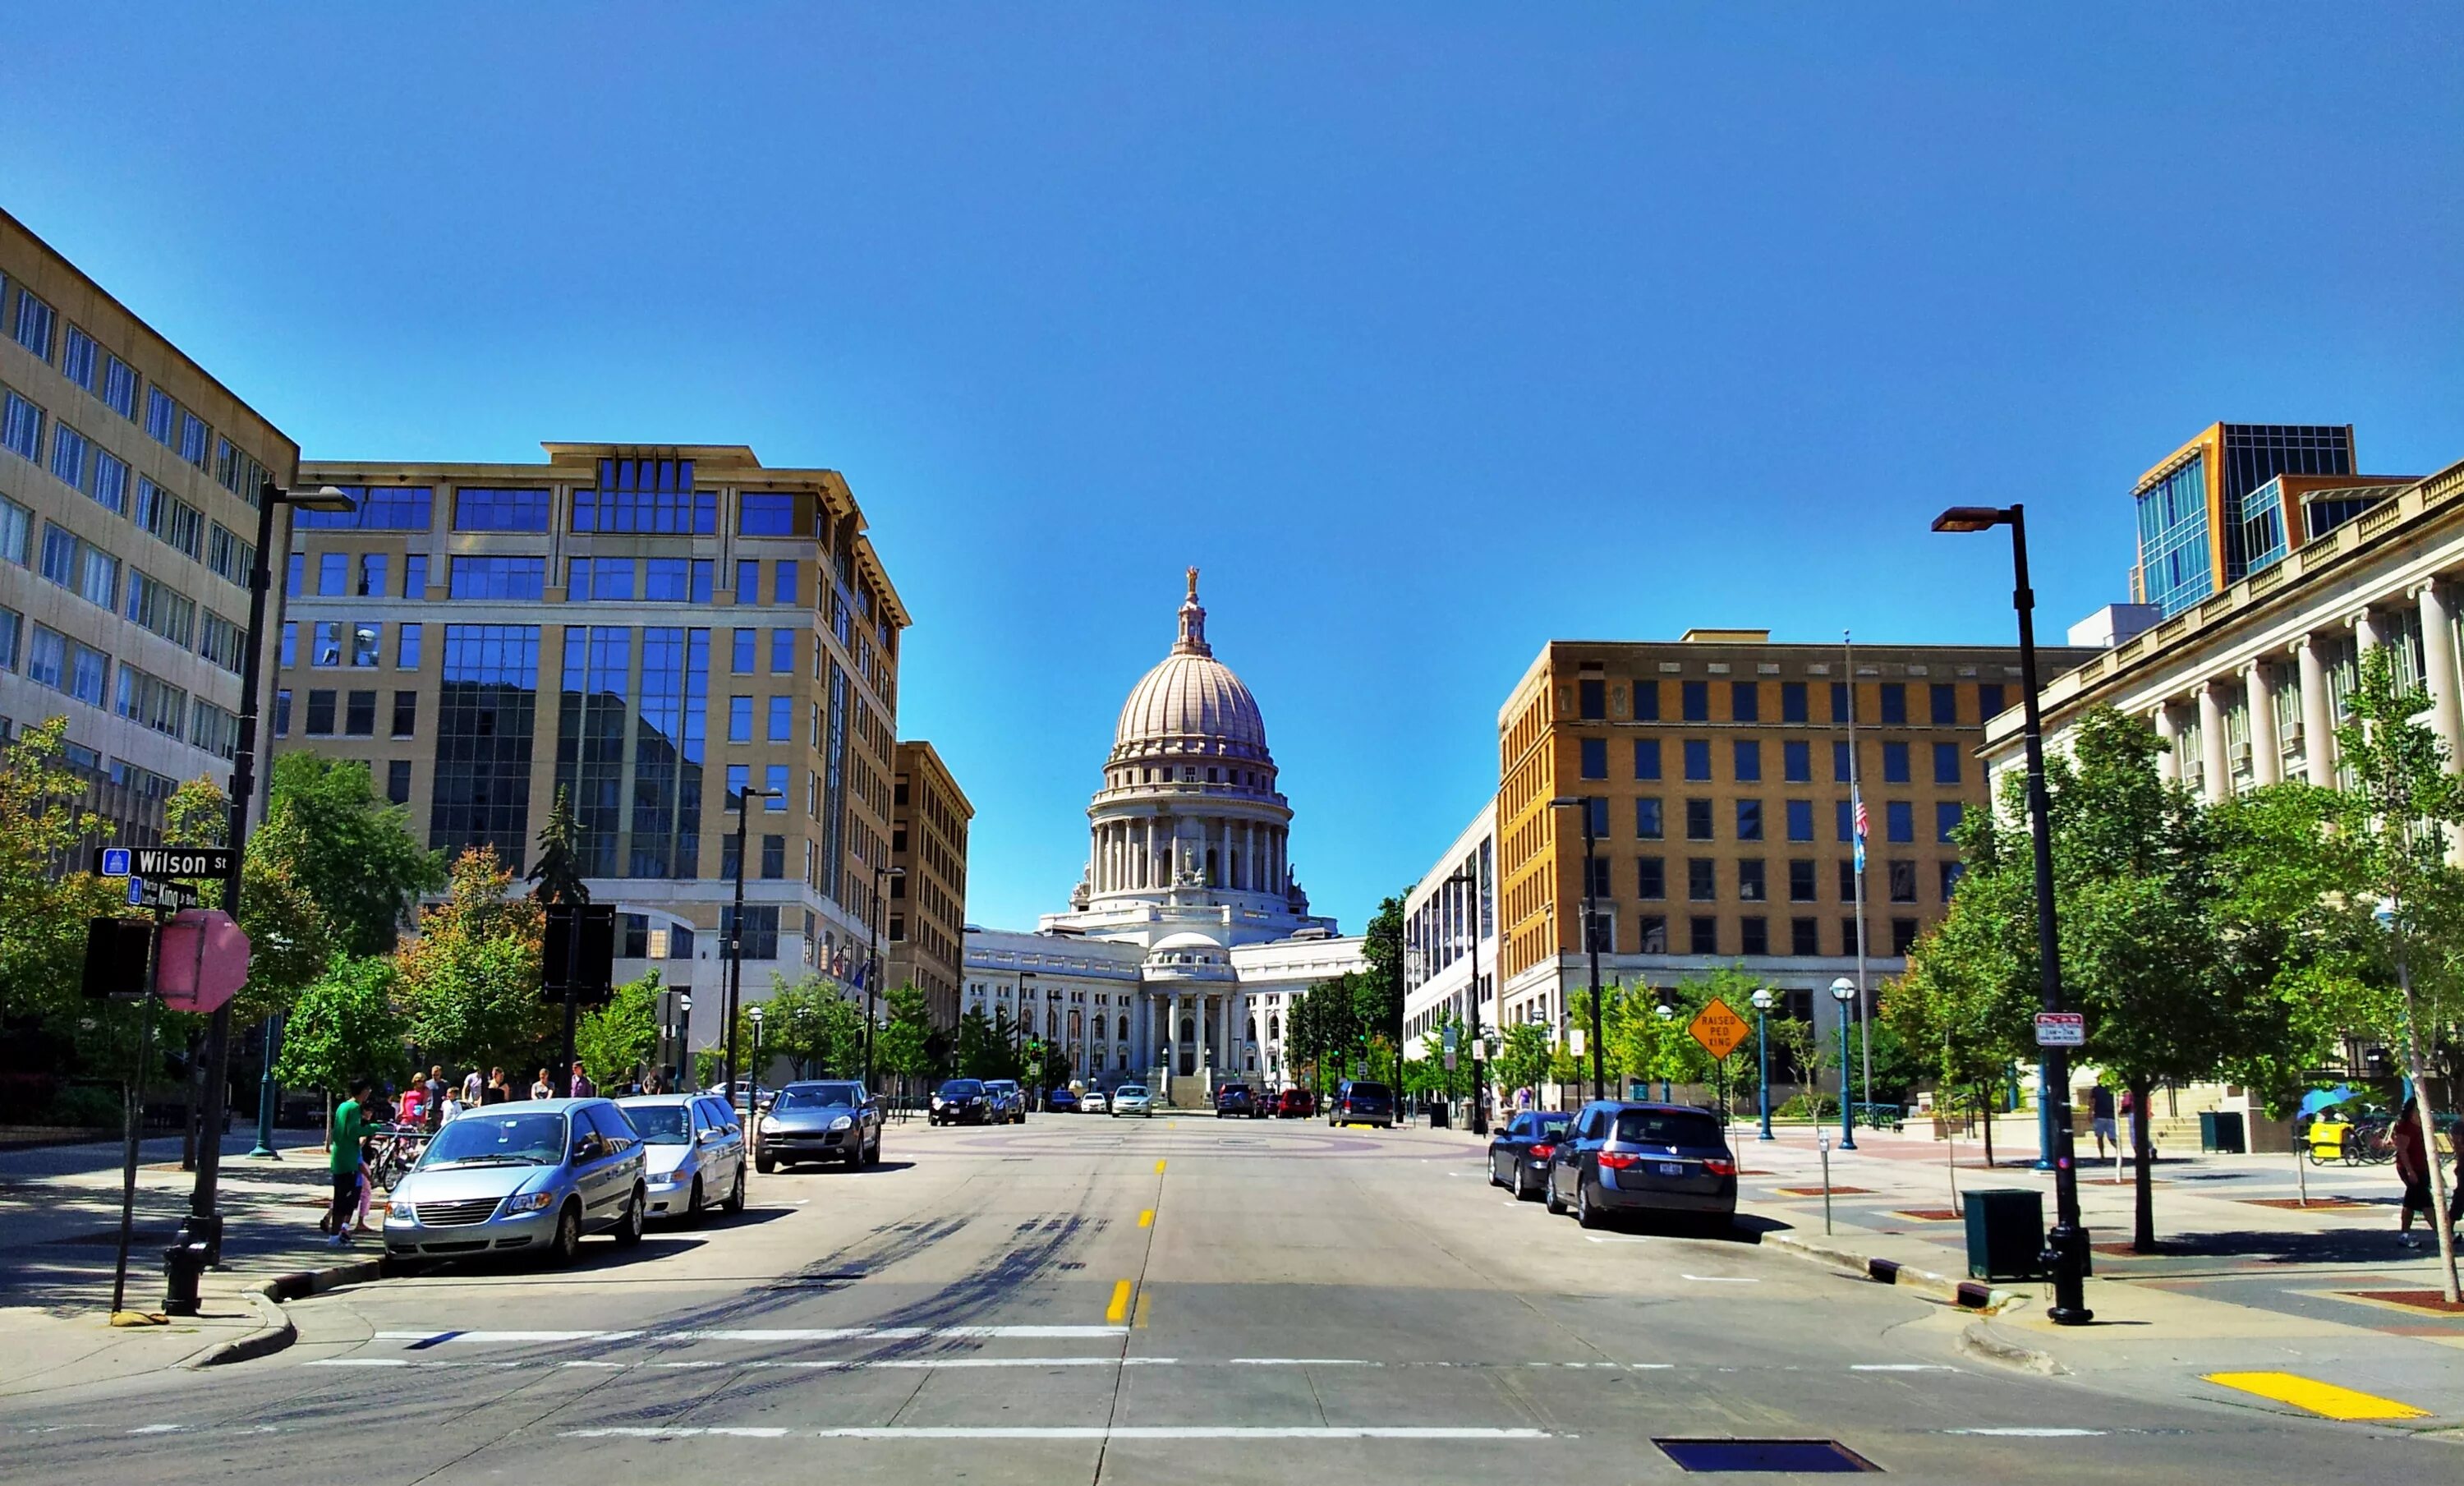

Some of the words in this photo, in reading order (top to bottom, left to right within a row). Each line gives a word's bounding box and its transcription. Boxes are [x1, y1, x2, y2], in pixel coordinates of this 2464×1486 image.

[140, 850, 206, 874] Wilson
[214, 856, 227, 869] St
[159, 882, 178, 914] King
[1702, 1015, 1736, 1025] RAISED
[1710, 1027, 1729, 1036] PED
[1708, 1037, 1731, 1047] XING
